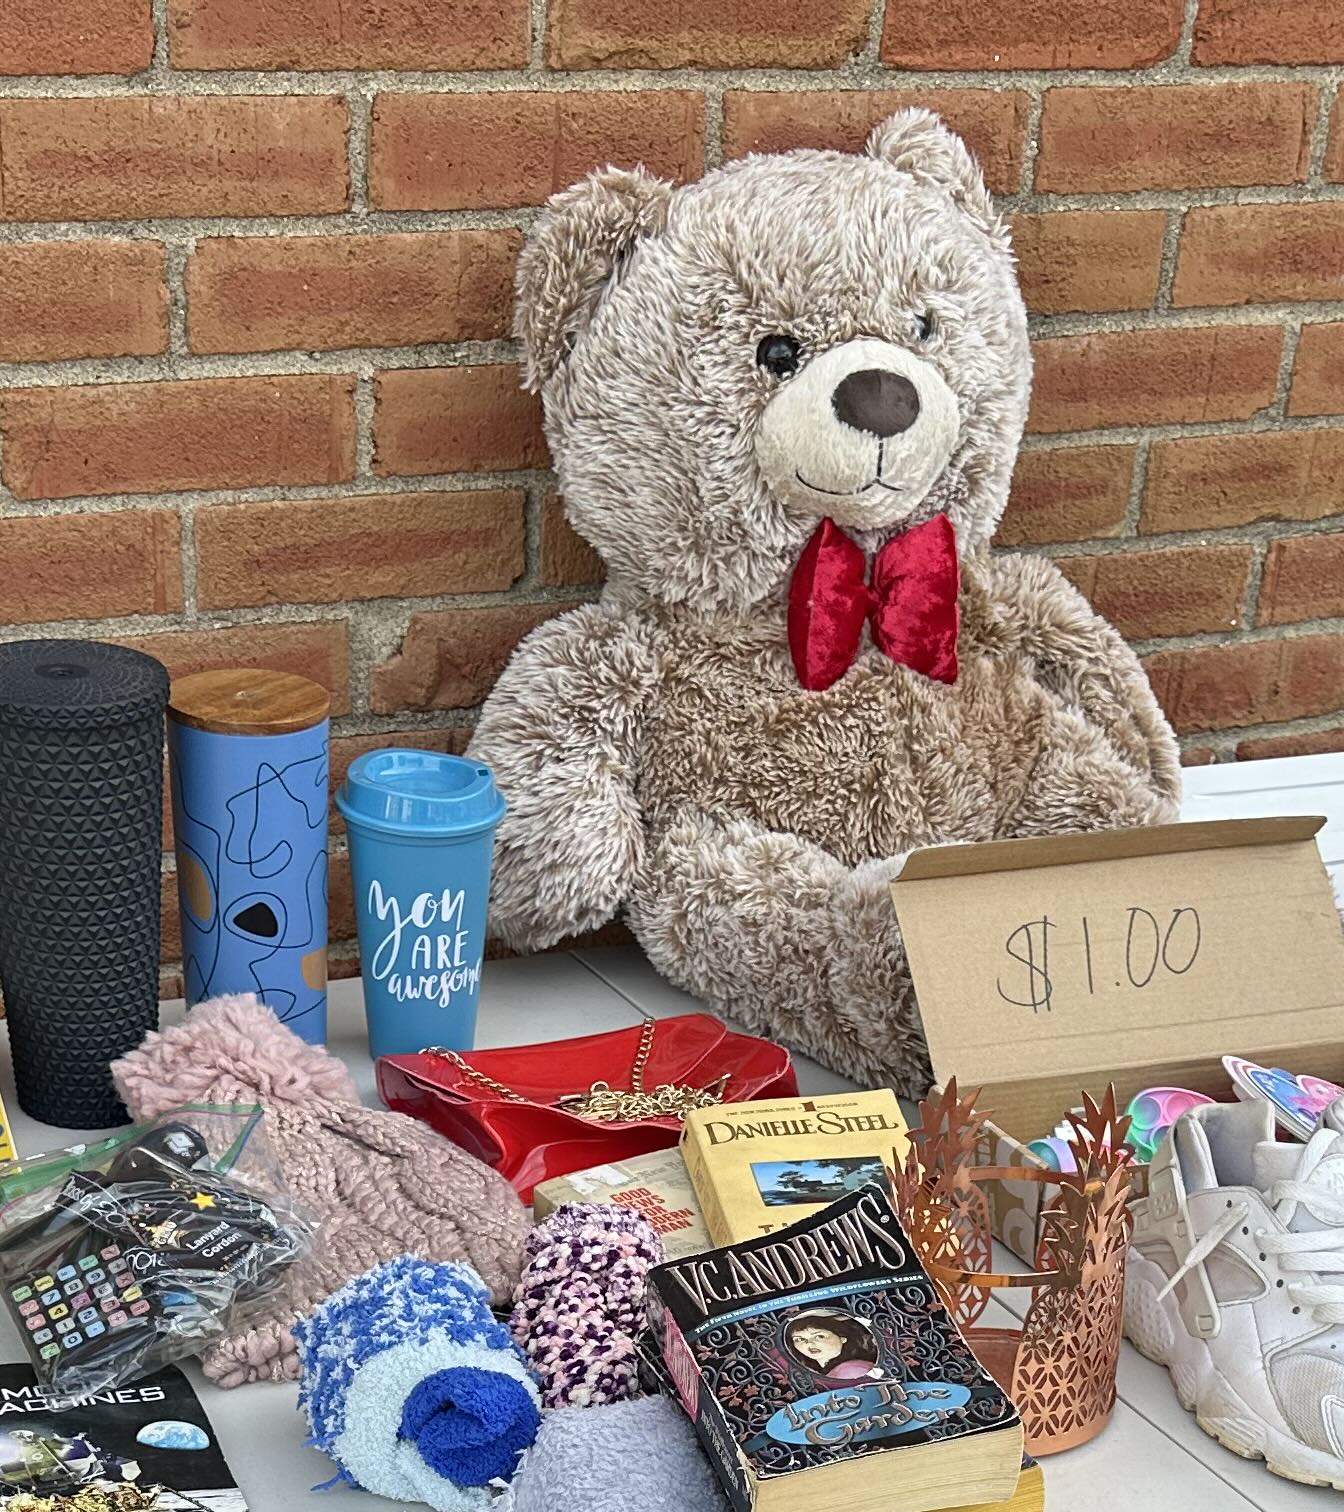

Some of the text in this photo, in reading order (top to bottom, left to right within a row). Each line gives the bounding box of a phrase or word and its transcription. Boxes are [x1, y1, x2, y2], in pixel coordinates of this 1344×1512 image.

[368, 880, 465, 980] You
[411, 930, 469, 970] ARE
[997, 907, 1200, 1013] $1.00
[704, 1112, 900, 1146] DANIELLE STEEL
[610, 1187, 652, 1203] GOOD
[186, 1221, 230, 1250] Lanyard
[202, 1232, 242, 1258] Cordon
[783, 1378, 954, 1432] Into The
[806, 1400, 971, 1448] Garden
